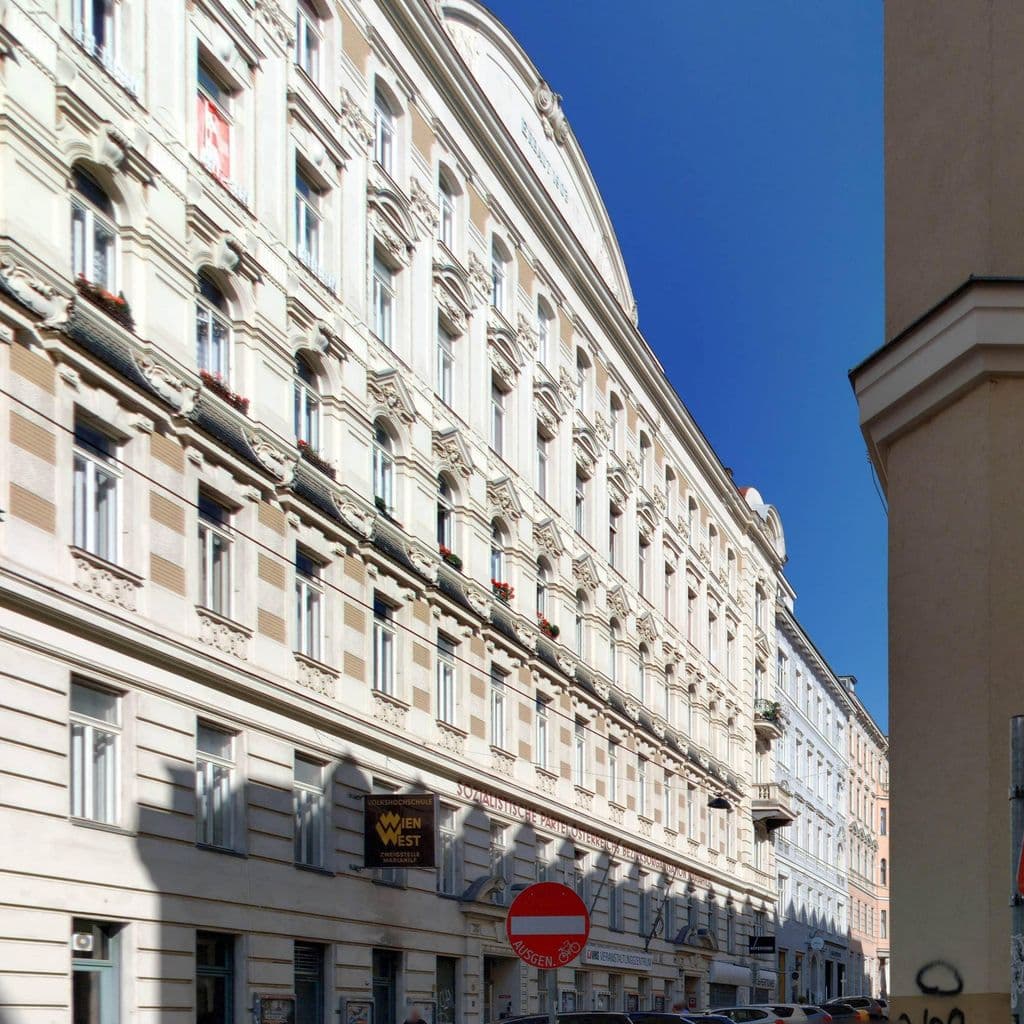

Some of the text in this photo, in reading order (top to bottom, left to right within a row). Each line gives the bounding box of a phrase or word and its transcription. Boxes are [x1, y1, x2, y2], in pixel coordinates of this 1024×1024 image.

[456, 783, 537, 823] SOZIALISTISCHE
[380, 811, 421, 829] WIEN
[376, 822, 421, 846] WEST
[513, 940, 557, 967] AUSGEN.
